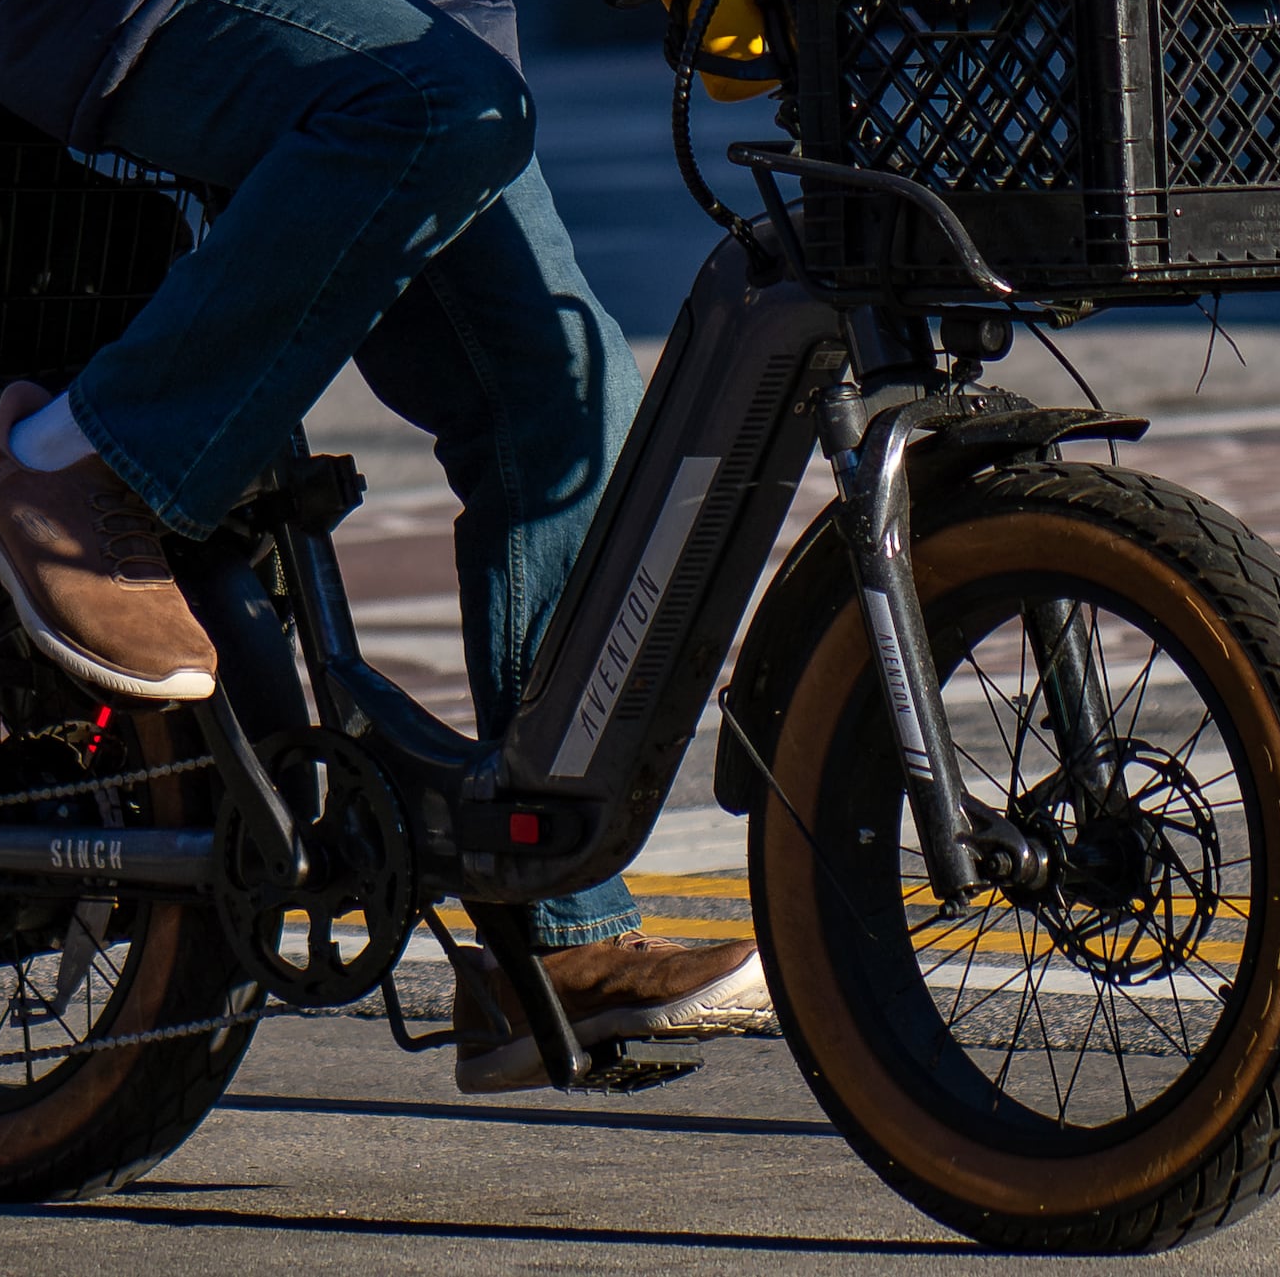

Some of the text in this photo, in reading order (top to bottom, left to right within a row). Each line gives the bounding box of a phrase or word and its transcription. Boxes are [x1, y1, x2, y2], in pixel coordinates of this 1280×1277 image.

[581, 565, 661, 741] AVENTON
[876, 631, 912, 716] AVENTON
[50, 838, 123, 870] SINCH
